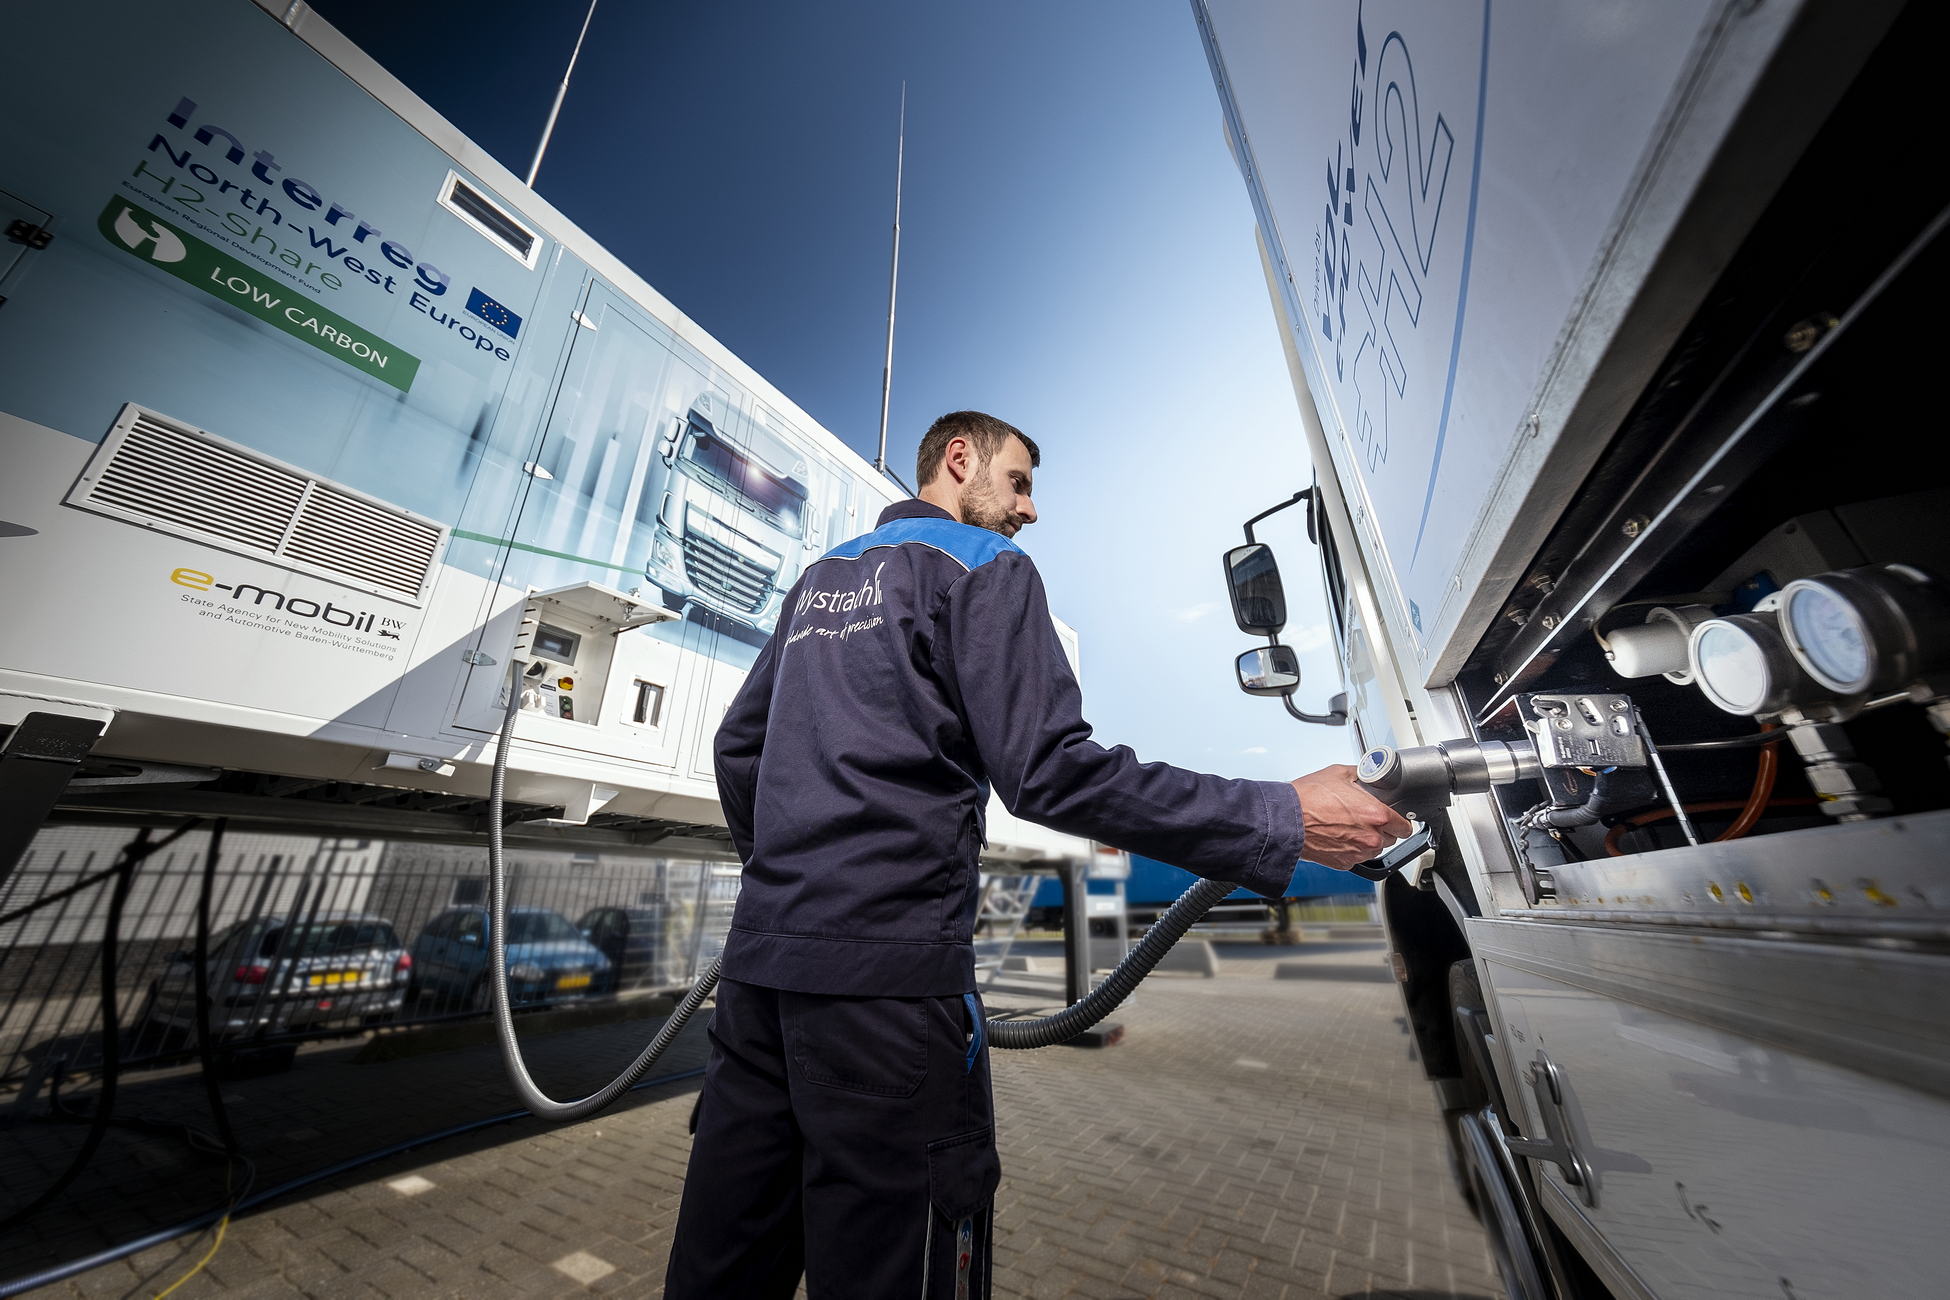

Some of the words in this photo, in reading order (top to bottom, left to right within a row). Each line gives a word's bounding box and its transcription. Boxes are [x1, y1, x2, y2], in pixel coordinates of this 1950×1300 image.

[121, 180, 179, 215] European
[182, 213, 230, 243] Regional
[231, 241, 297, 280] Development
[298, 278, 321, 294] Fund
[132, 159, 343, 291] H2-Share
[148, 133, 397, 294] North-West
[409, 291, 510, 361] Europe
[166, 96, 451, 296] Interreg
[1323, 139, 1341, 342] VDL
[210, 266, 281, 310] LOW
[285, 306, 389, 369] CARBON
[462, 310, 496, 334] EUROPEAN
[170, 567, 376, 633] e-mobil
[381, 617, 407, 630] BW
[181, 594, 214, 608] State
[217, 603, 263, 620] Agency
[265, 614, 281, 624] for
[284, 619, 312, 631] New
[312, 626, 352, 642] Mobility
[355, 637, 397, 653] Solutions
[198, 609, 222, 620] and
[225, 615, 292, 635] Automotive
[295, 631, 394, 661] Baden-Württemberg
